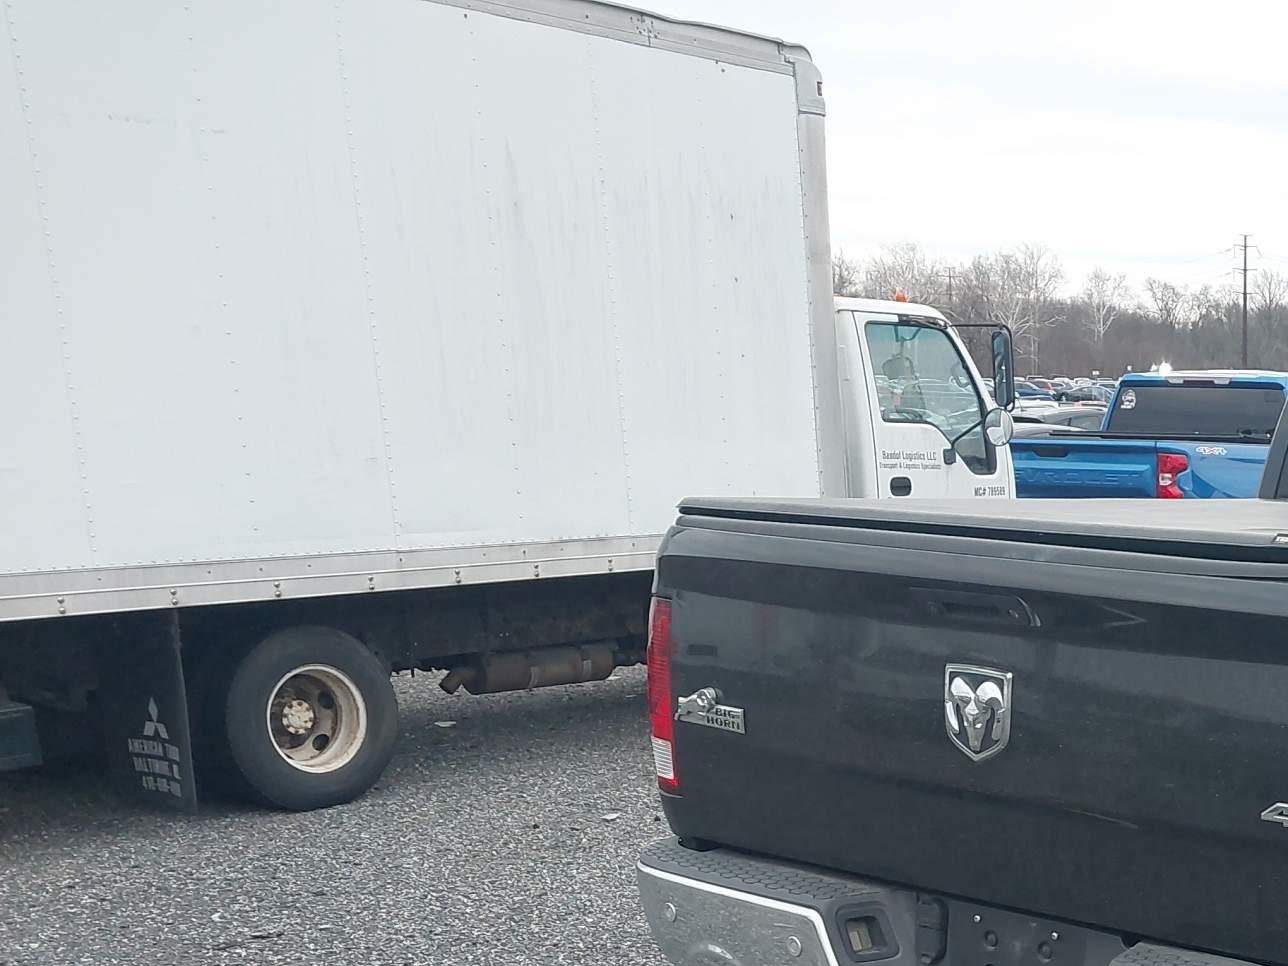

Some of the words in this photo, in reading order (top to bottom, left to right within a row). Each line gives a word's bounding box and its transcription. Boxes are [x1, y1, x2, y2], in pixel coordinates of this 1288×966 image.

[926, 451, 937, 460] LLC
[1015, 470, 1141, 486] EVROLET
[974, 487, 987, 497] MC#
[715, 707, 741, 720] BIG
[706, 715, 741, 730] HORN
